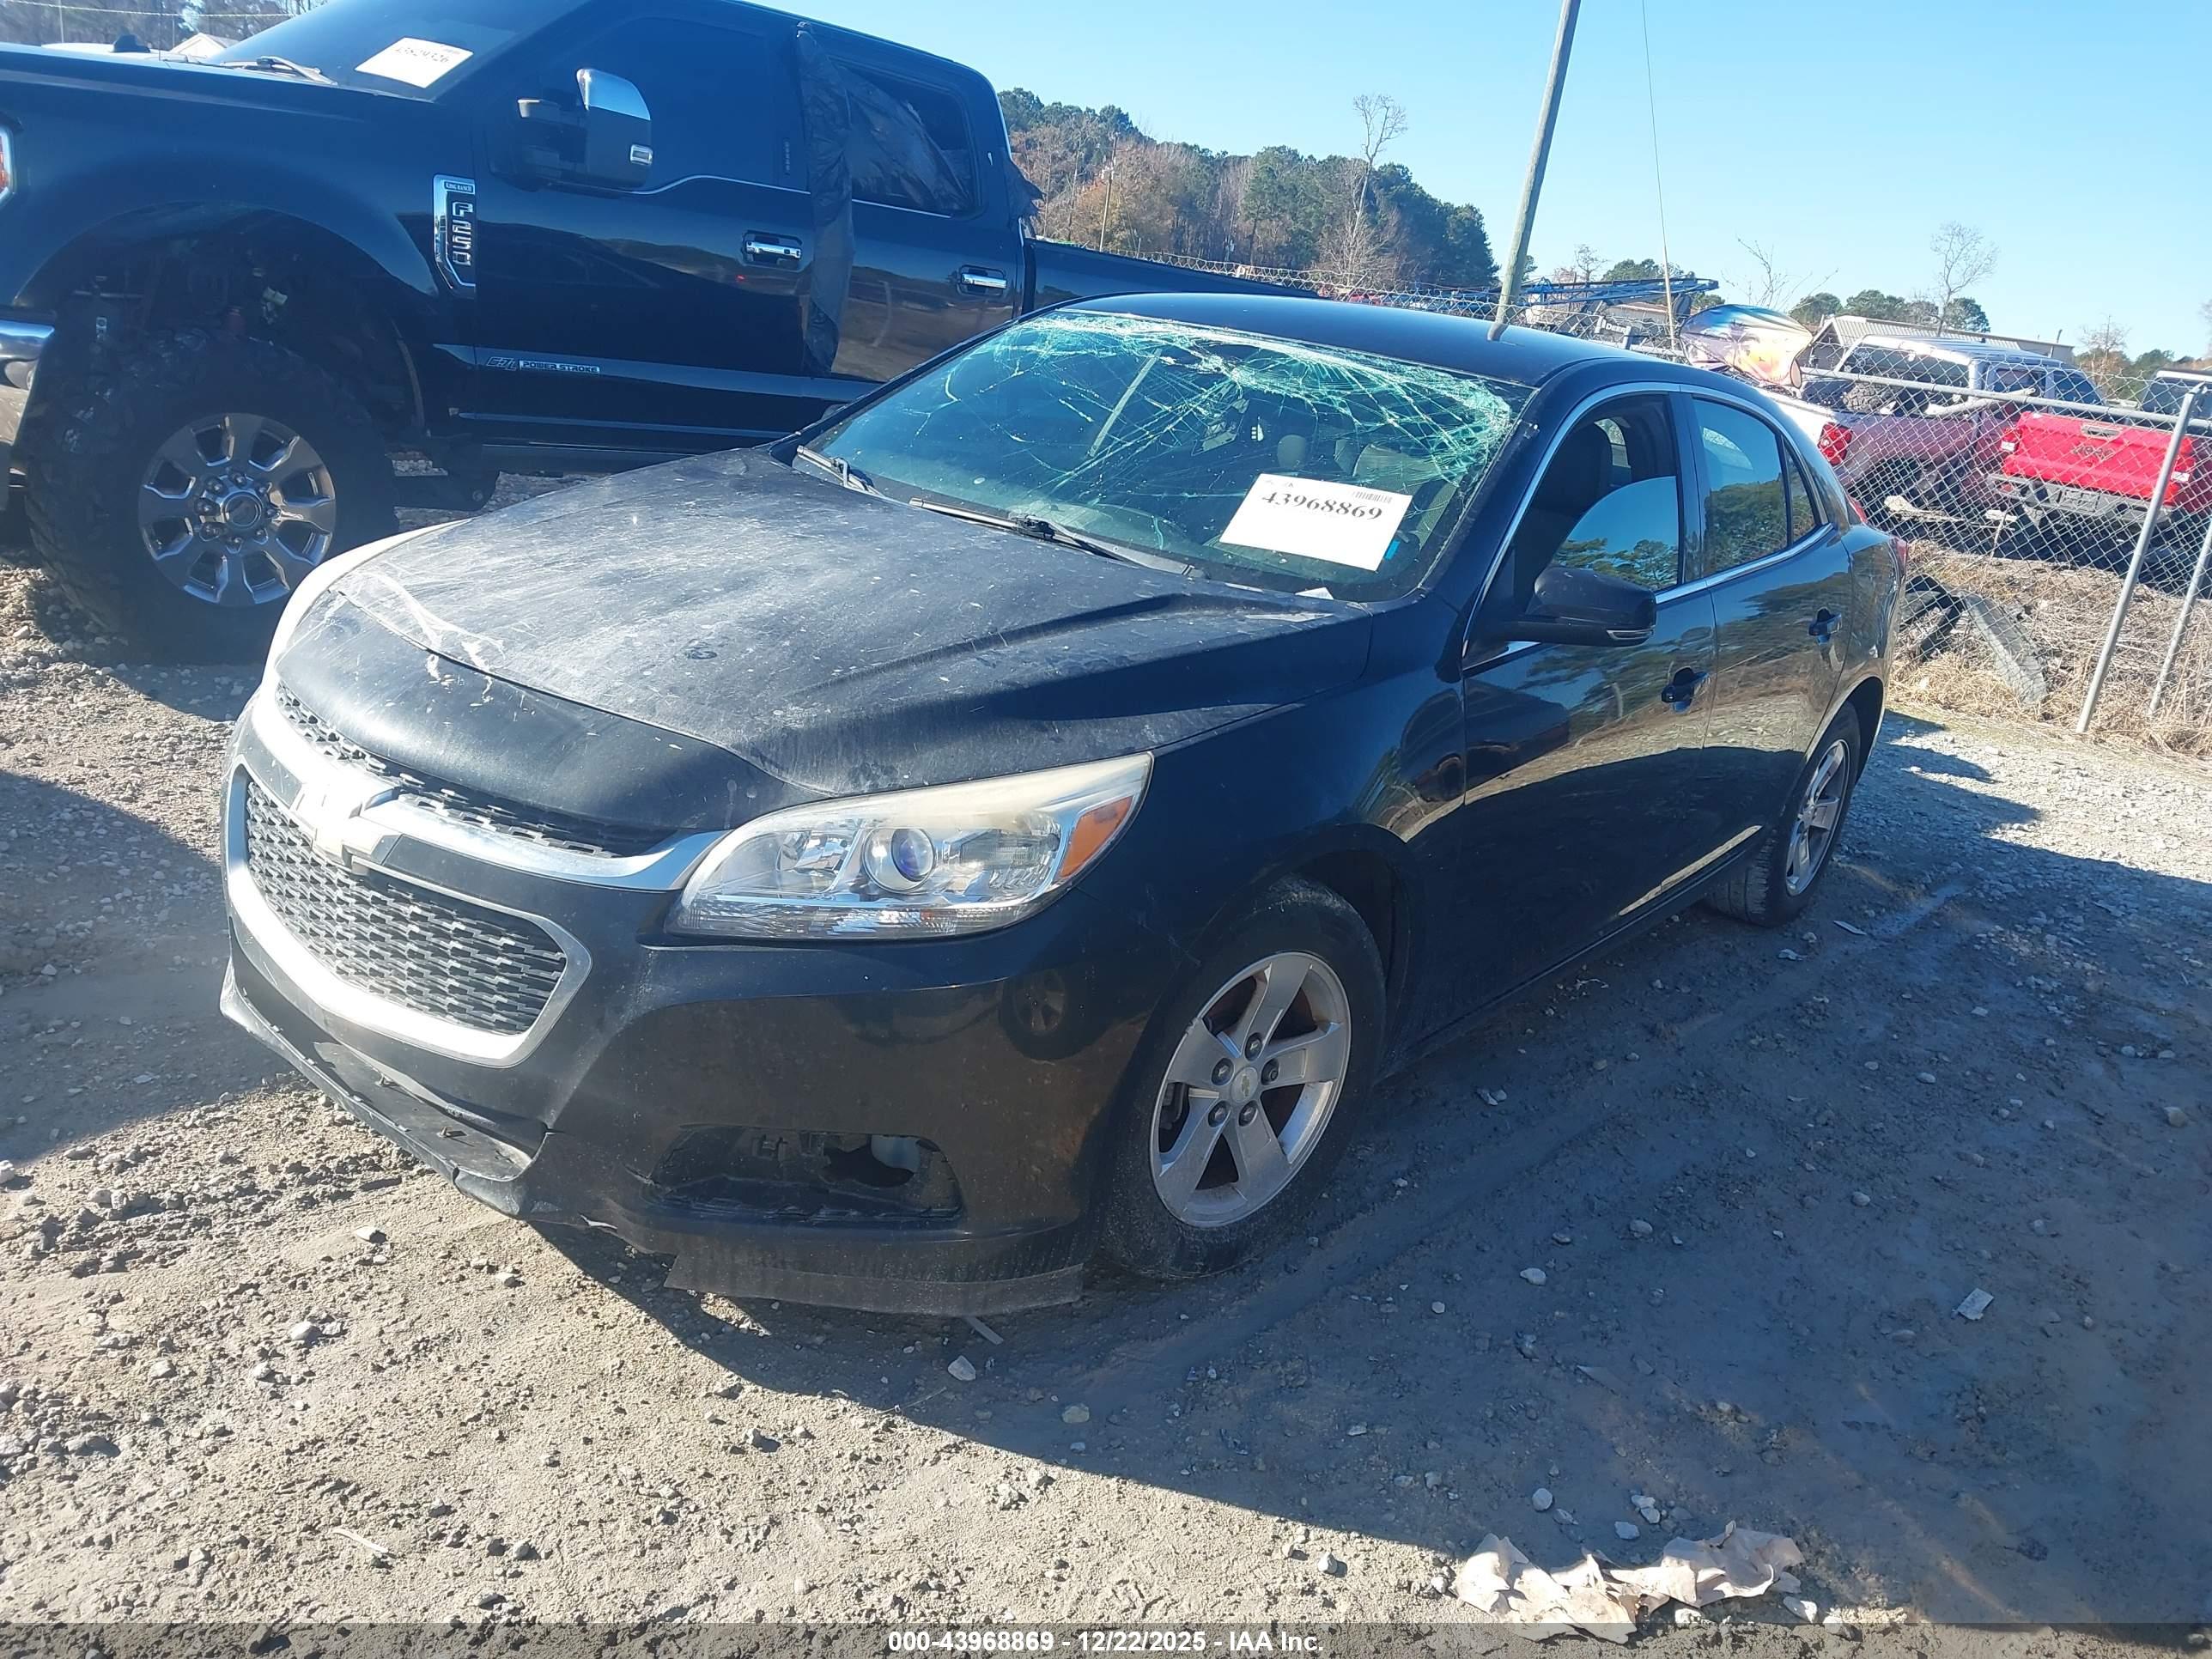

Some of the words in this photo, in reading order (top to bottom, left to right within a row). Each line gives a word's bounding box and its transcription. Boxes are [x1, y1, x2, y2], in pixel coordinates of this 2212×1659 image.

[522, 361, 557, 370] POWER
[558, 364, 599, 373] STROKE
[1261, 491, 1382, 520] 43968869
